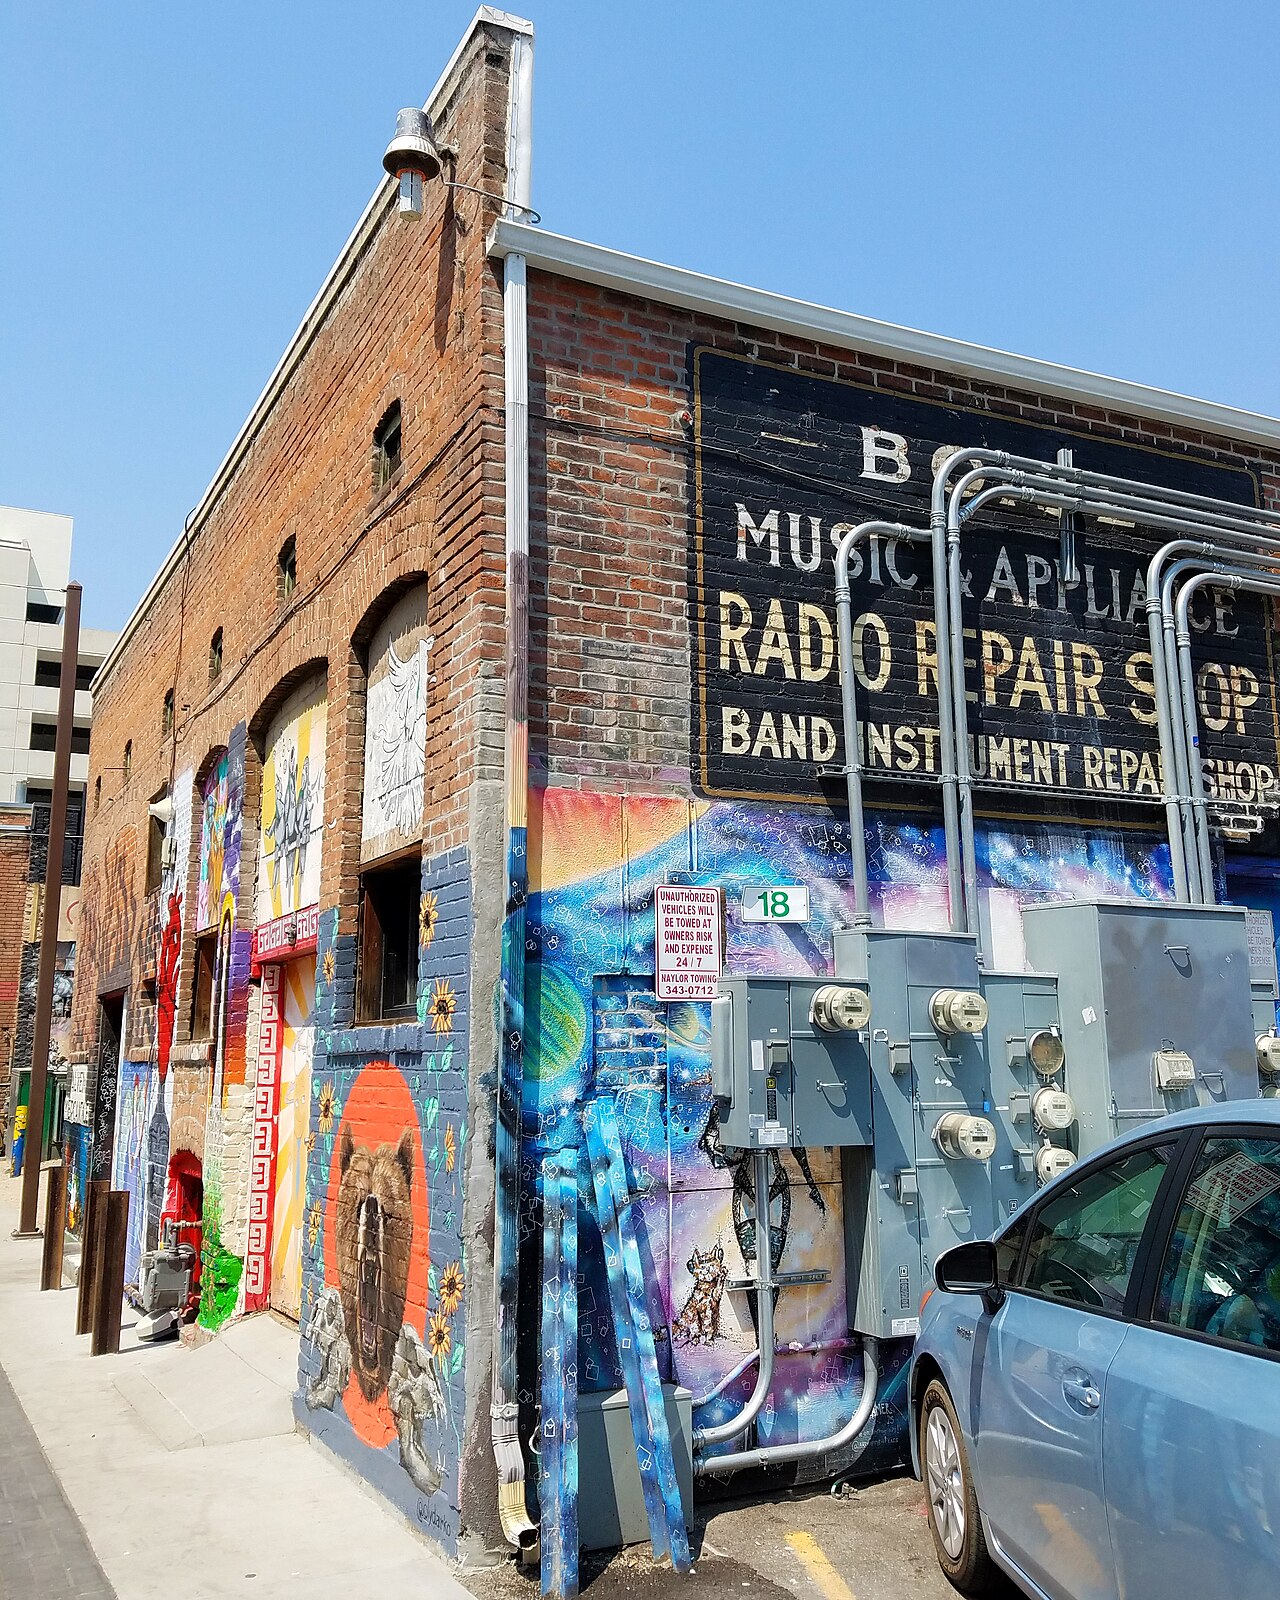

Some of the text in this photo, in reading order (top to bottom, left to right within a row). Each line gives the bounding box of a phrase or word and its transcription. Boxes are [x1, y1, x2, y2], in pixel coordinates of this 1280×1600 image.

[734, 502, 919, 590] MUSIC
[983, 545, 1240, 639] APPLIACE
[719, 590, 892, 692] RADO
[1124, 651, 1260, 736] SOP
[719, 706, 1274, 803] BAND INSTUMENT REPAI SHOP
[661, 891, 715, 904] UNAUTHORIZED
[662, 904, 715, 916] VEHICLES WILL
[757, 891, 790, 918] 18
[664, 917, 712, 929] BE TOWED AT
[664, 930, 713, 942] OWNERS RISK
[664, 943, 714, 955] AND EXPENSE
[675, 956, 688, 968] 24
[696, 957, 702, 968] 7
[661, 973, 717, 984] NAYLOR TOWING
[665, 985, 714, 995] 343-0712
